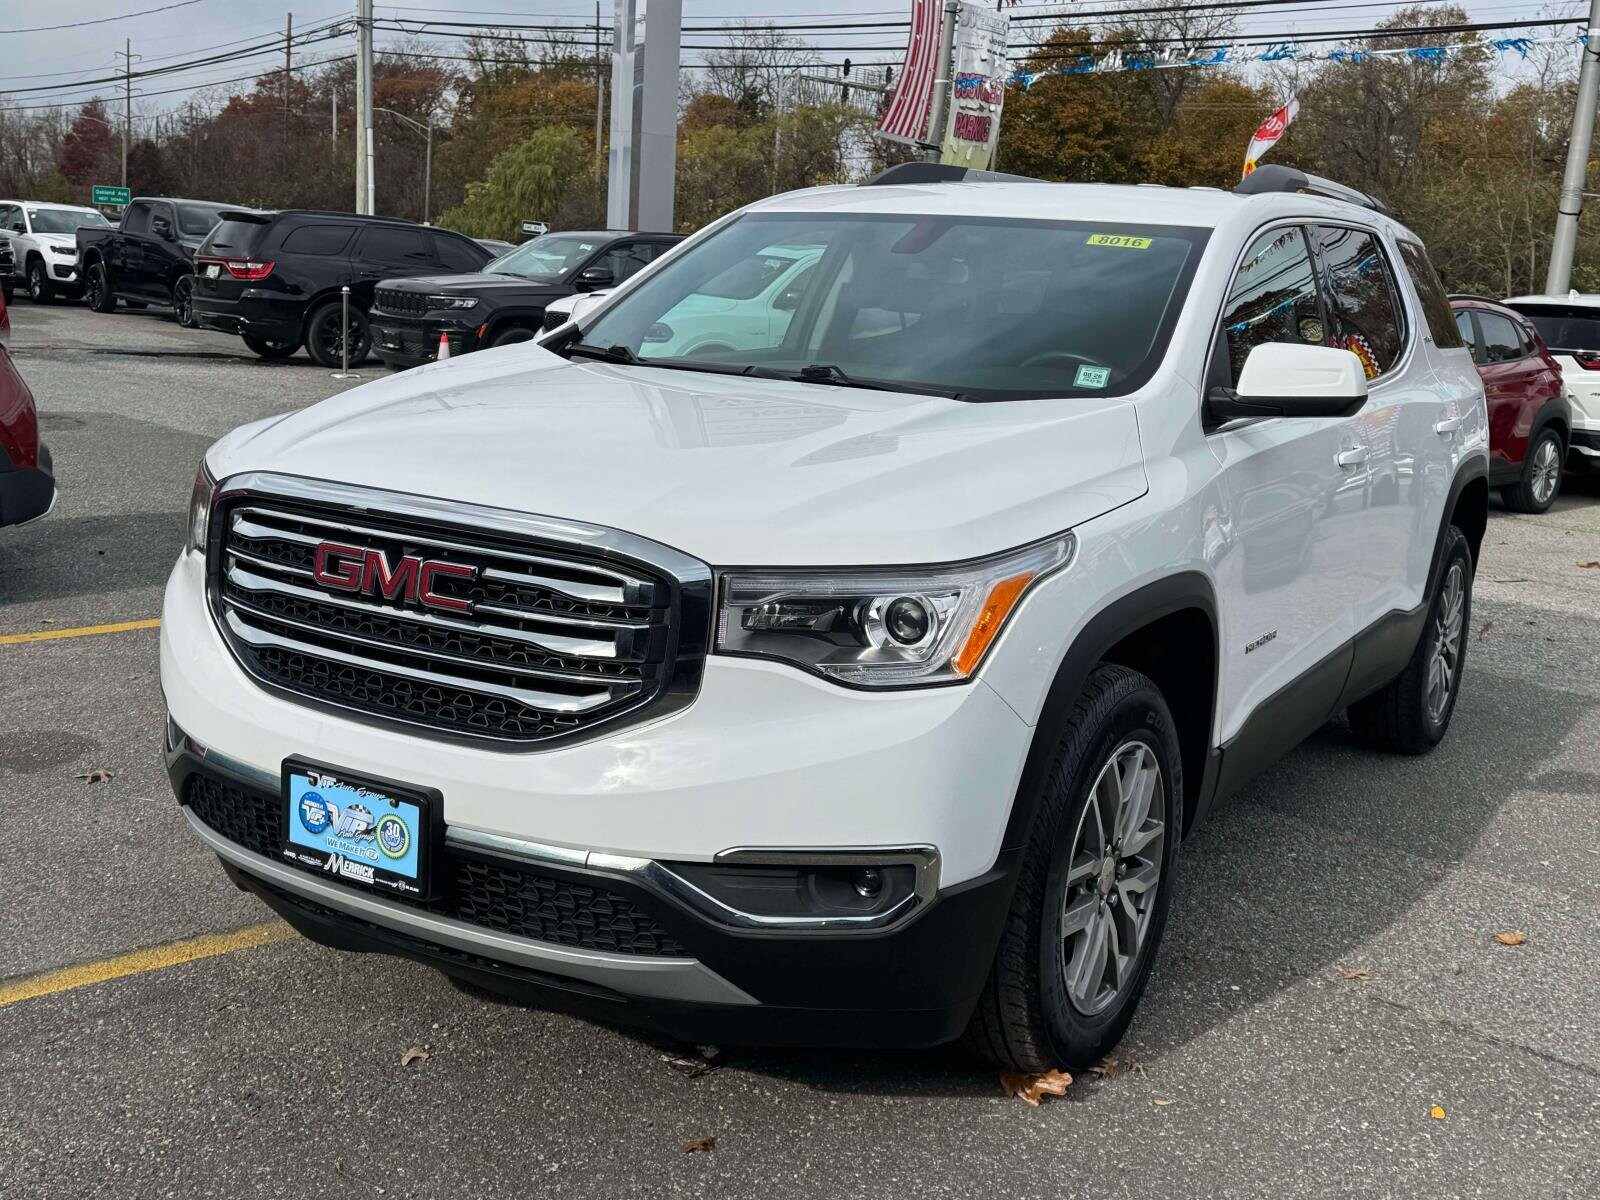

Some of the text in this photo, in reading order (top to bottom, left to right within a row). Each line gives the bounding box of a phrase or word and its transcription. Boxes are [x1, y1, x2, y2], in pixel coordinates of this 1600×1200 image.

[989, 37, 1005, 47] Jeep
[1098, 236, 1143, 247] 8016
[313, 540, 478, 615] GMC
[335, 781, 355, 792] Auto
[327, 803, 374, 834] VIP
[385, 822, 400, 838] 30
[323, 853, 375, 884] MERRICK
